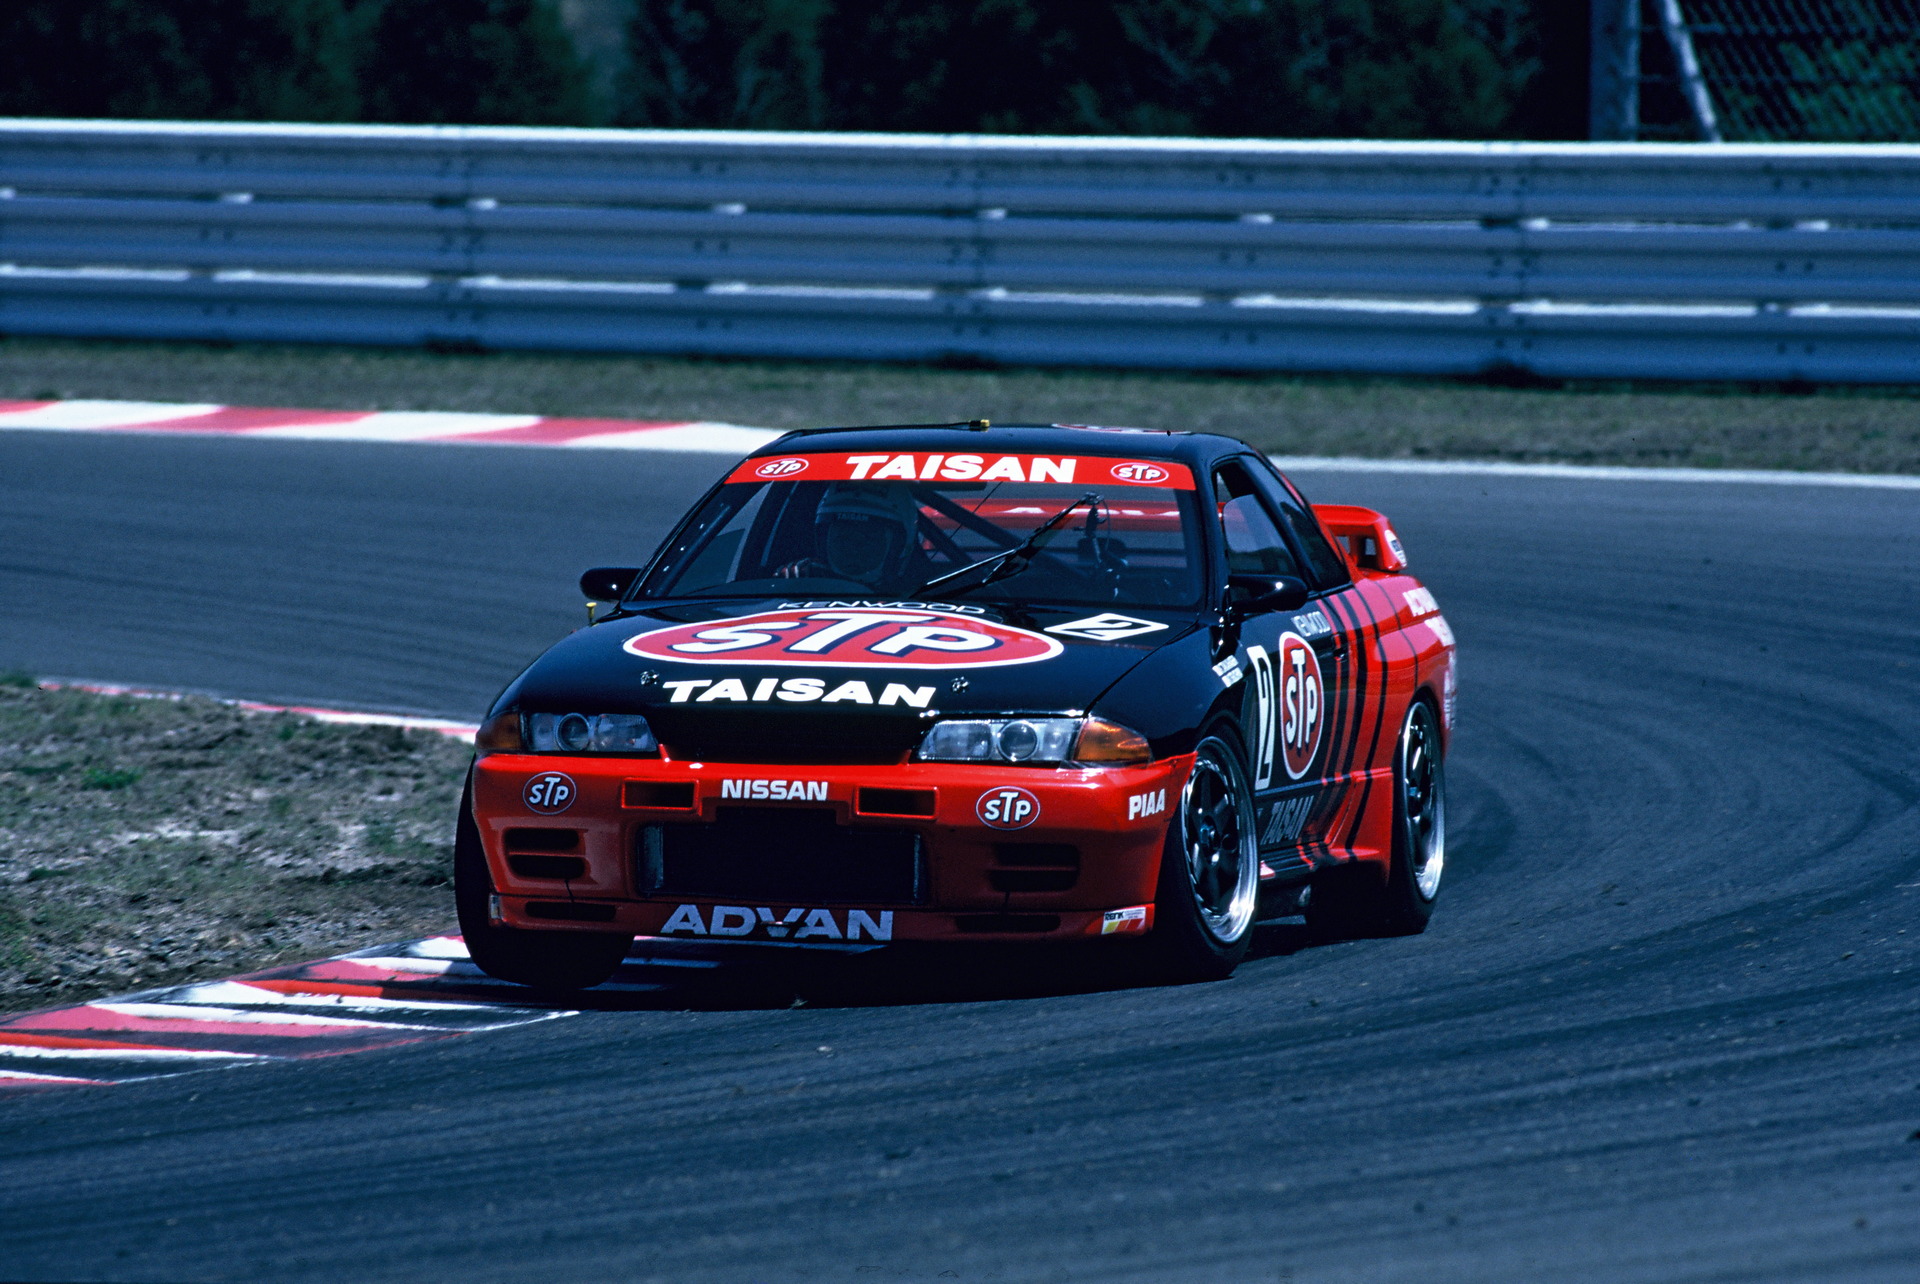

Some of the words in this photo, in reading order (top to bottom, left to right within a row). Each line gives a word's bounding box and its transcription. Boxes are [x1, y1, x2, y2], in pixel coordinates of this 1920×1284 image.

[760, 458, 803, 476] STP
[846, 455, 1077, 483] TAISAN
[1117, 463, 1161, 482] STP
[777, 601, 985, 615] KENWOOD
[672, 613, 996, 658] STP
[663, 678, 937, 708] TAISAN
[1286, 648, 1319, 750] STP
[529, 777, 570, 807] STP
[721, 779, 829, 801] NISSAN
[1128, 788, 1165, 821] PIAA
[984, 791, 1032, 822] STP
[660, 904, 894, 941] ADVAN
